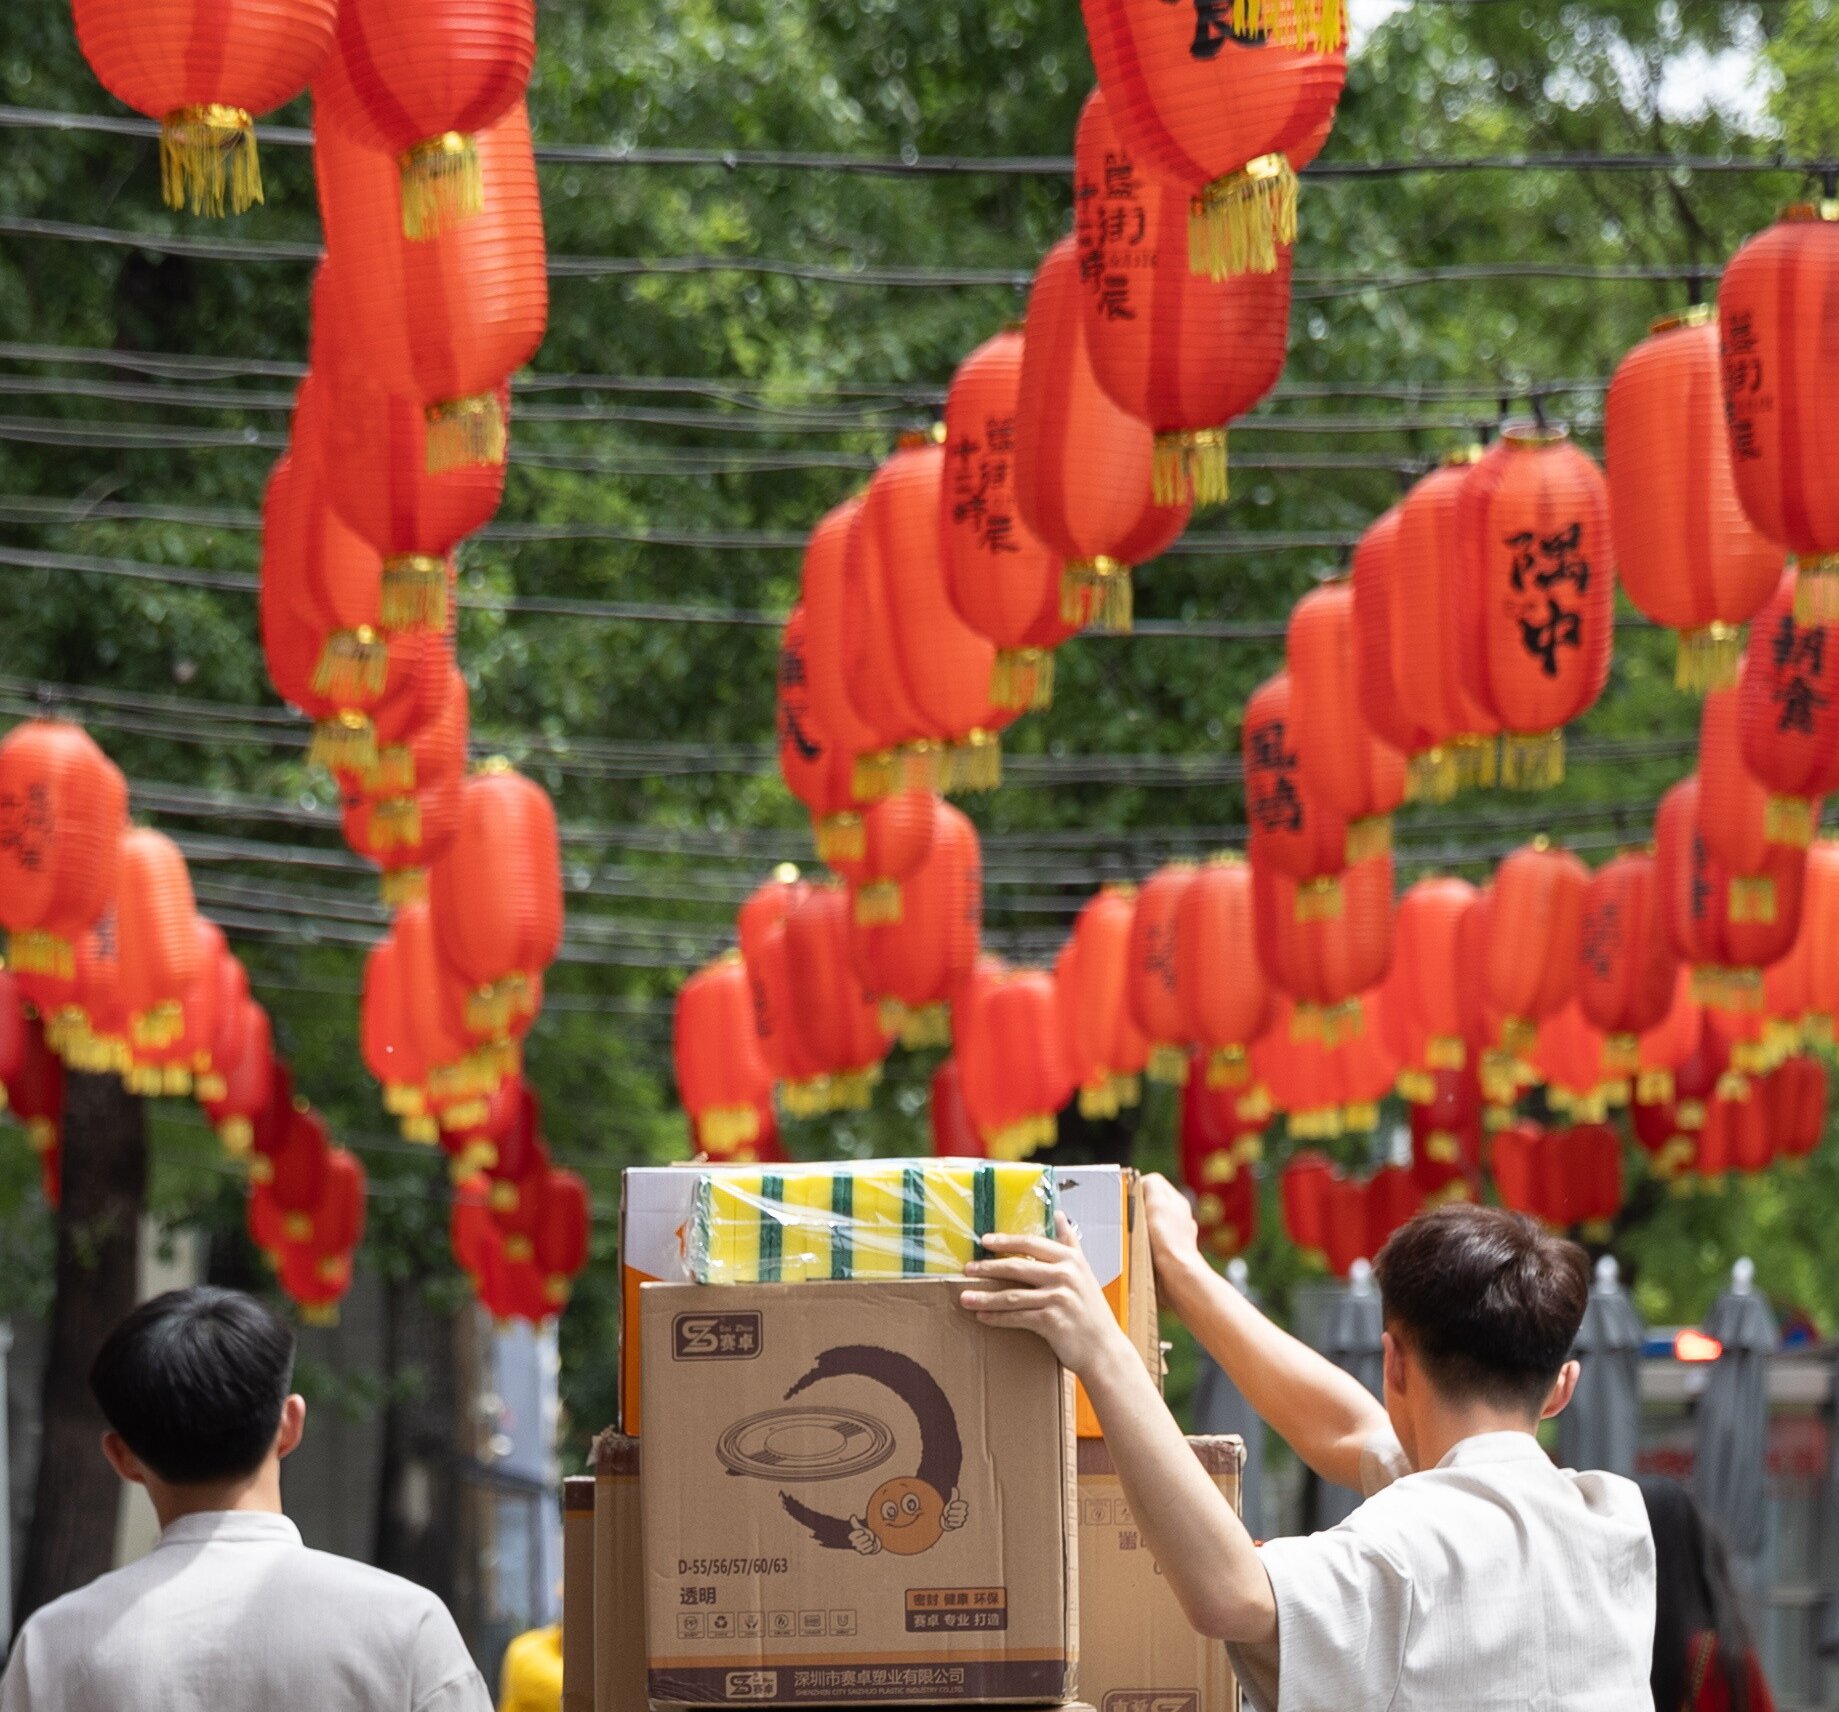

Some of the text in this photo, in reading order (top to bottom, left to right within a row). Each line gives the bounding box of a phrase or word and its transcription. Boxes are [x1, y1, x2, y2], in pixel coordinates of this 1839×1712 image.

[720, 1333, 755, 1351] 赛卓
[678, 1558, 788, 1576] D-55/56/57/60/63
[680, 1586, 717, 1605] 透明
[974, 1592, 1000, 1605] 环保
[913, 1612, 1000, 1628] 赛卓 专业 打造
[794, 1667, 965, 1688] 深圳市赛卓塑业有限公司
